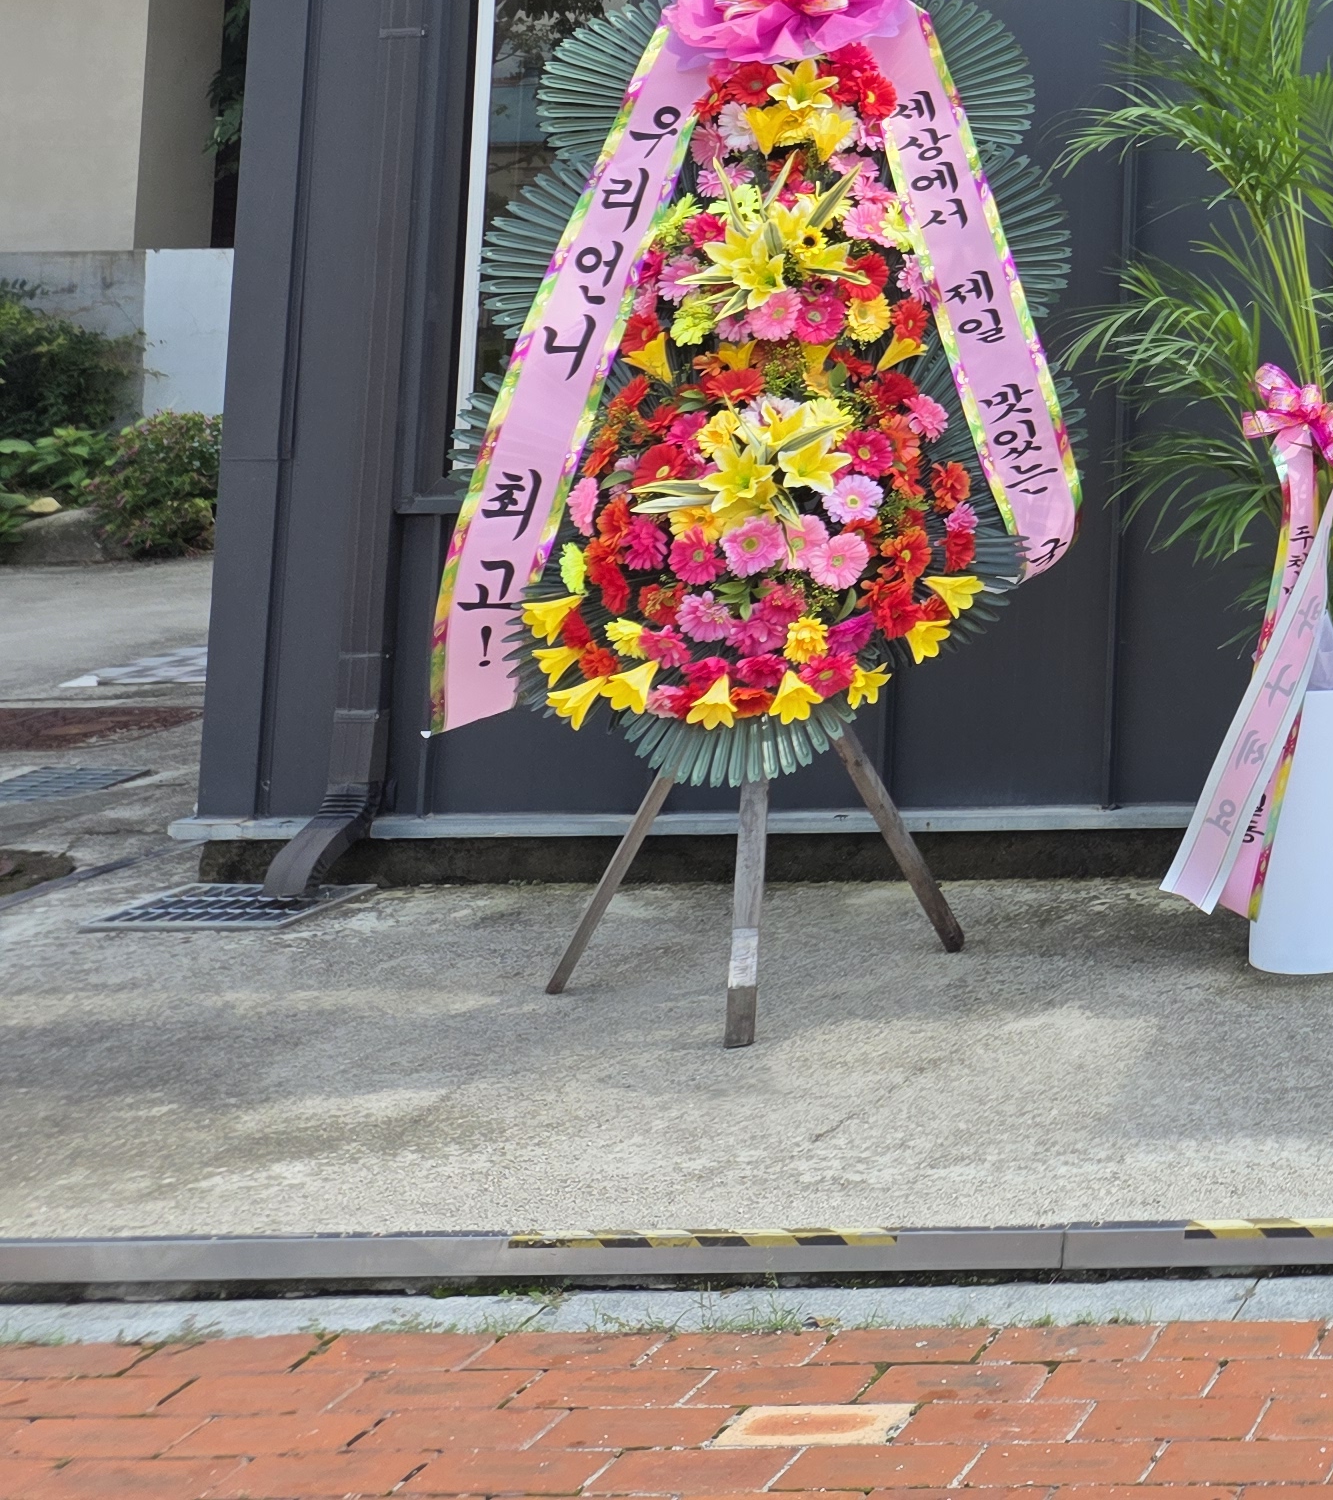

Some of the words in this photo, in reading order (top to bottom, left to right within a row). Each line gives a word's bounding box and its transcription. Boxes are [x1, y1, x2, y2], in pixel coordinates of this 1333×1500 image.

[542, 105, 681, 381] 우리언니
[890, 90, 968, 229] 세상에서
[944, 269, 1005, 344] 제일
[978, 383, 1058, 495] 맛있는
[1030, 538, 1067, 576] 국
[457, 468, 542, 668] 최고!
